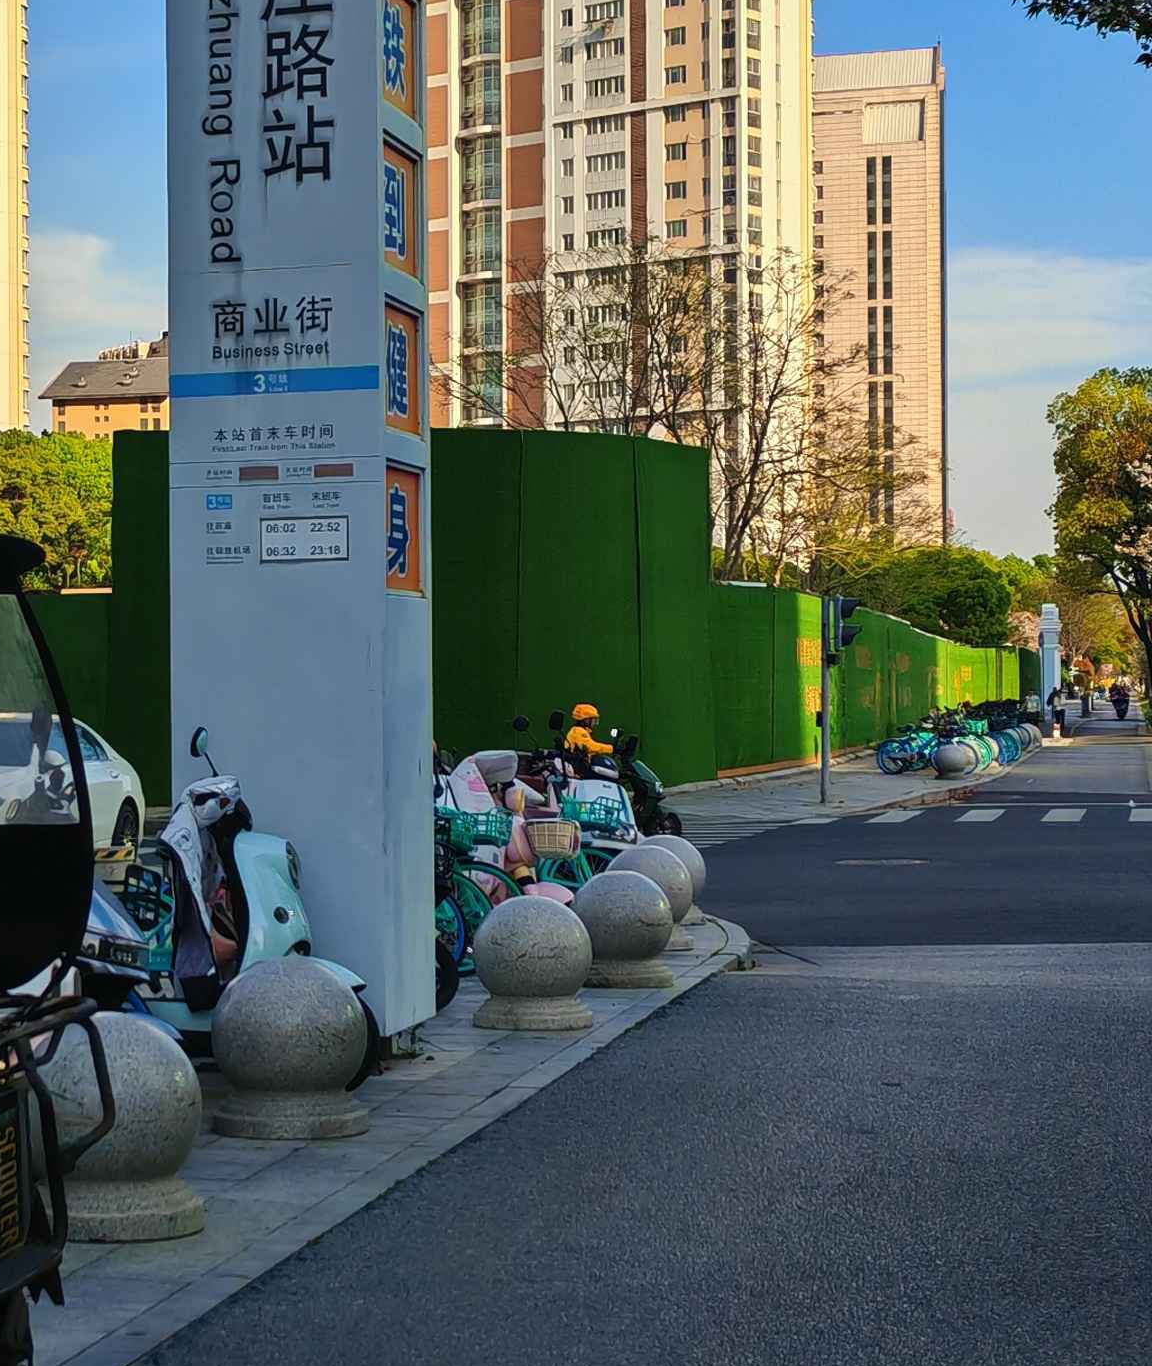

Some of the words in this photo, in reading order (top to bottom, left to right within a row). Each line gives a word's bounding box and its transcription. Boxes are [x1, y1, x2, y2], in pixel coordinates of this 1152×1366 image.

[209, 159, 242, 264] Road
[212, 296, 332, 339] 商业街
[212, 342, 279, 360] Business
[284, 339, 329, 356] Street
[253, 374, 266, 393] 3
[214, 424, 334, 442] 本站首末车时间
[266, 523, 296, 534] 06:02
[310, 522, 341, 532] 22:52
[310, 545, 341, 556] 23:18
